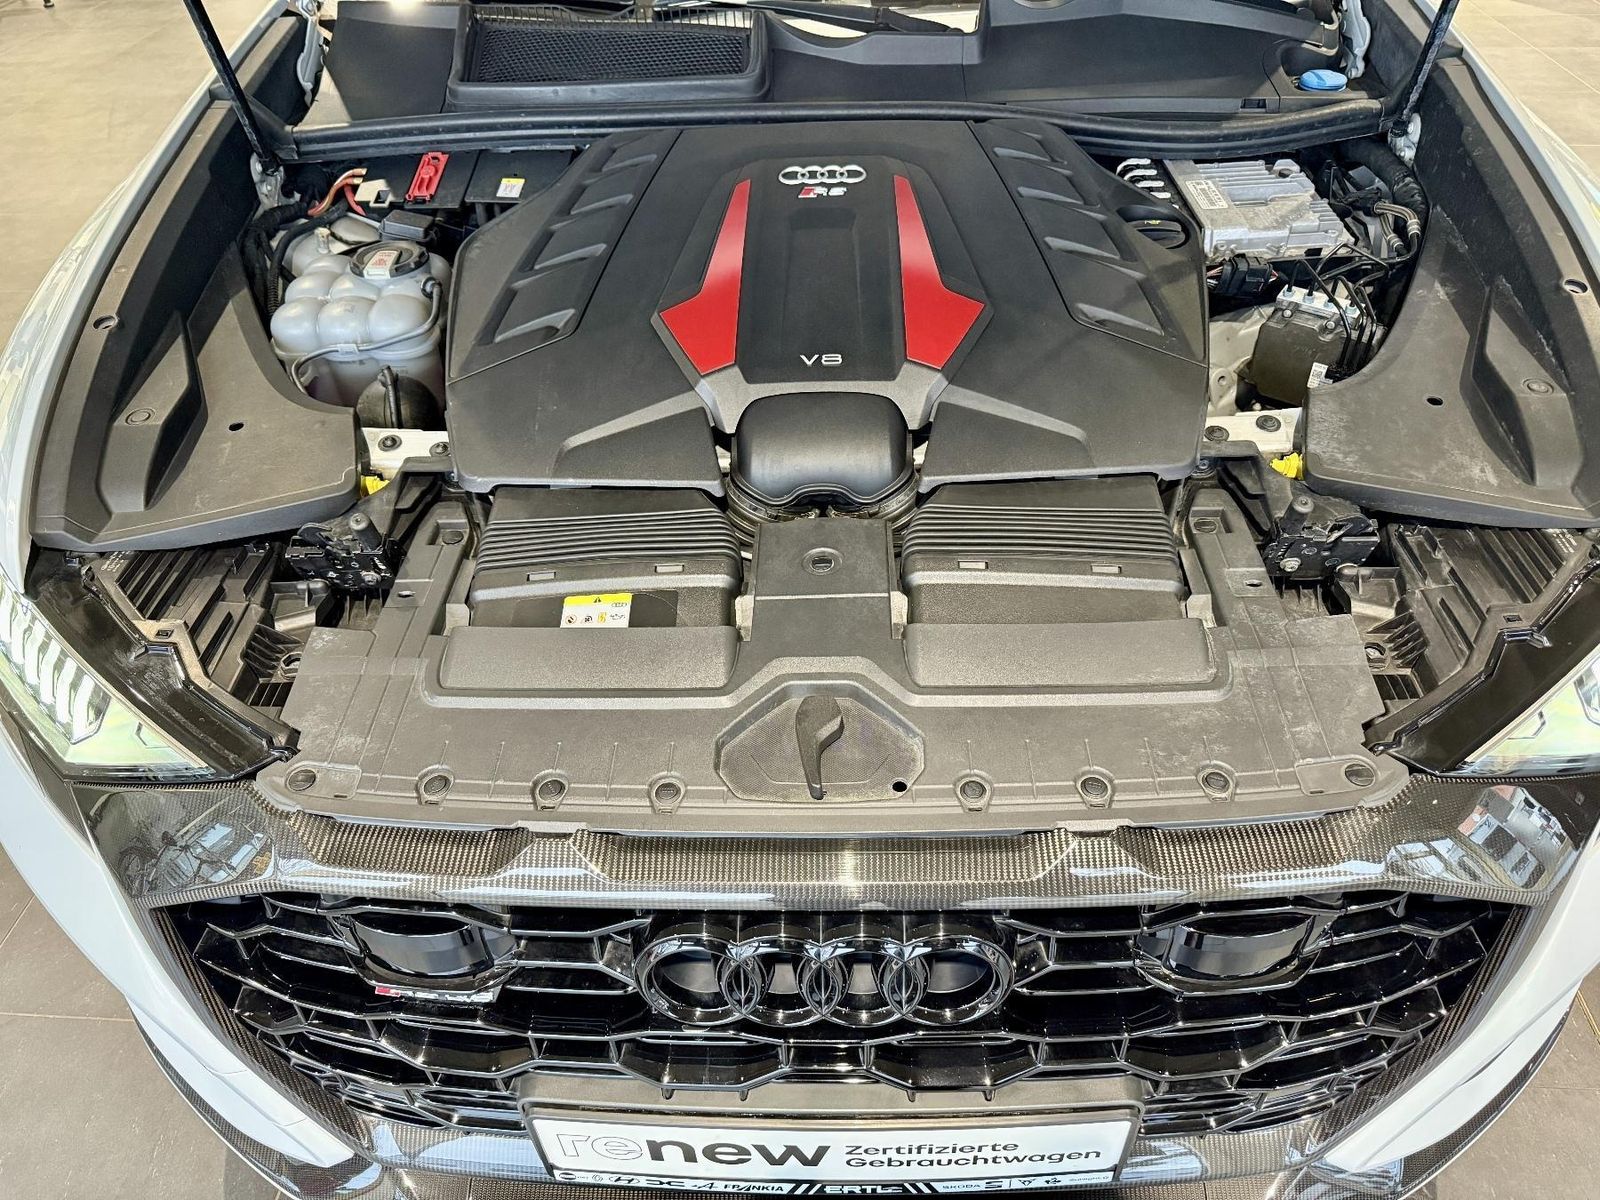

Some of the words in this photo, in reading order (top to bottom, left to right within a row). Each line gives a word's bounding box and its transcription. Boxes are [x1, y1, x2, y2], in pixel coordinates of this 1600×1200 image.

[798, 186, 847, 198] RS
[800, 354, 843, 367] V8
[556, 1133, 831, 1167] renew
[845, 1143, 1019, 1156] Zertifizierte
[845, 1150, 1101, 1168] Gebrauchtwagen
[723, 1183, 784, 1192] FRANKIA
